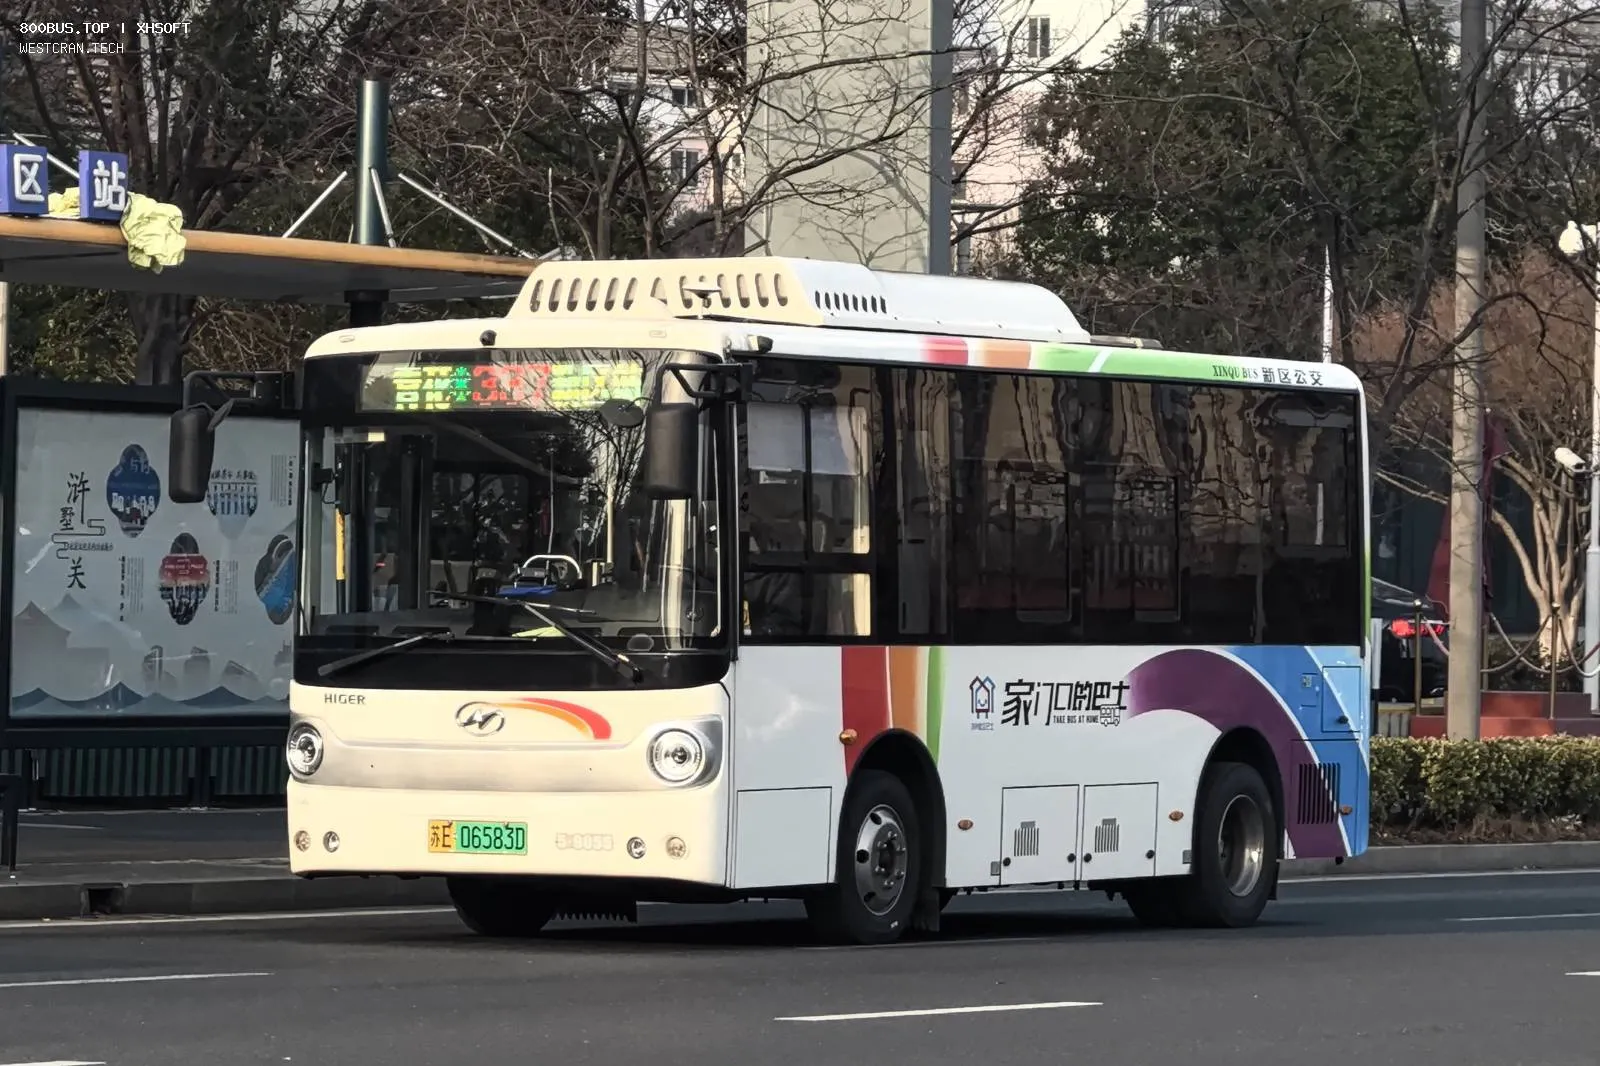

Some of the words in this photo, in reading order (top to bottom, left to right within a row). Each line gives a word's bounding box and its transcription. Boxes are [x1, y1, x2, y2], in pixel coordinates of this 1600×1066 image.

[1212, 365, 1241, 379] XINQU
[1242, 367, 1259, 379] BUS
[1261, 367, 1324, 386] 新区公交
[60, 472, 91, 589] 浒墅关
[324, 693, 366, 705] HIGER
[1001, 679, 1131, 727] 家门口的巴士
[1053, 715, 1066, 724] TAKE
[1067, 715, 1077, 724] BUS
[1078, 714, 1086, 723] AT
[1086, 714, 1099, 723] HOME
[460, 826, 525, 851] 06583D
